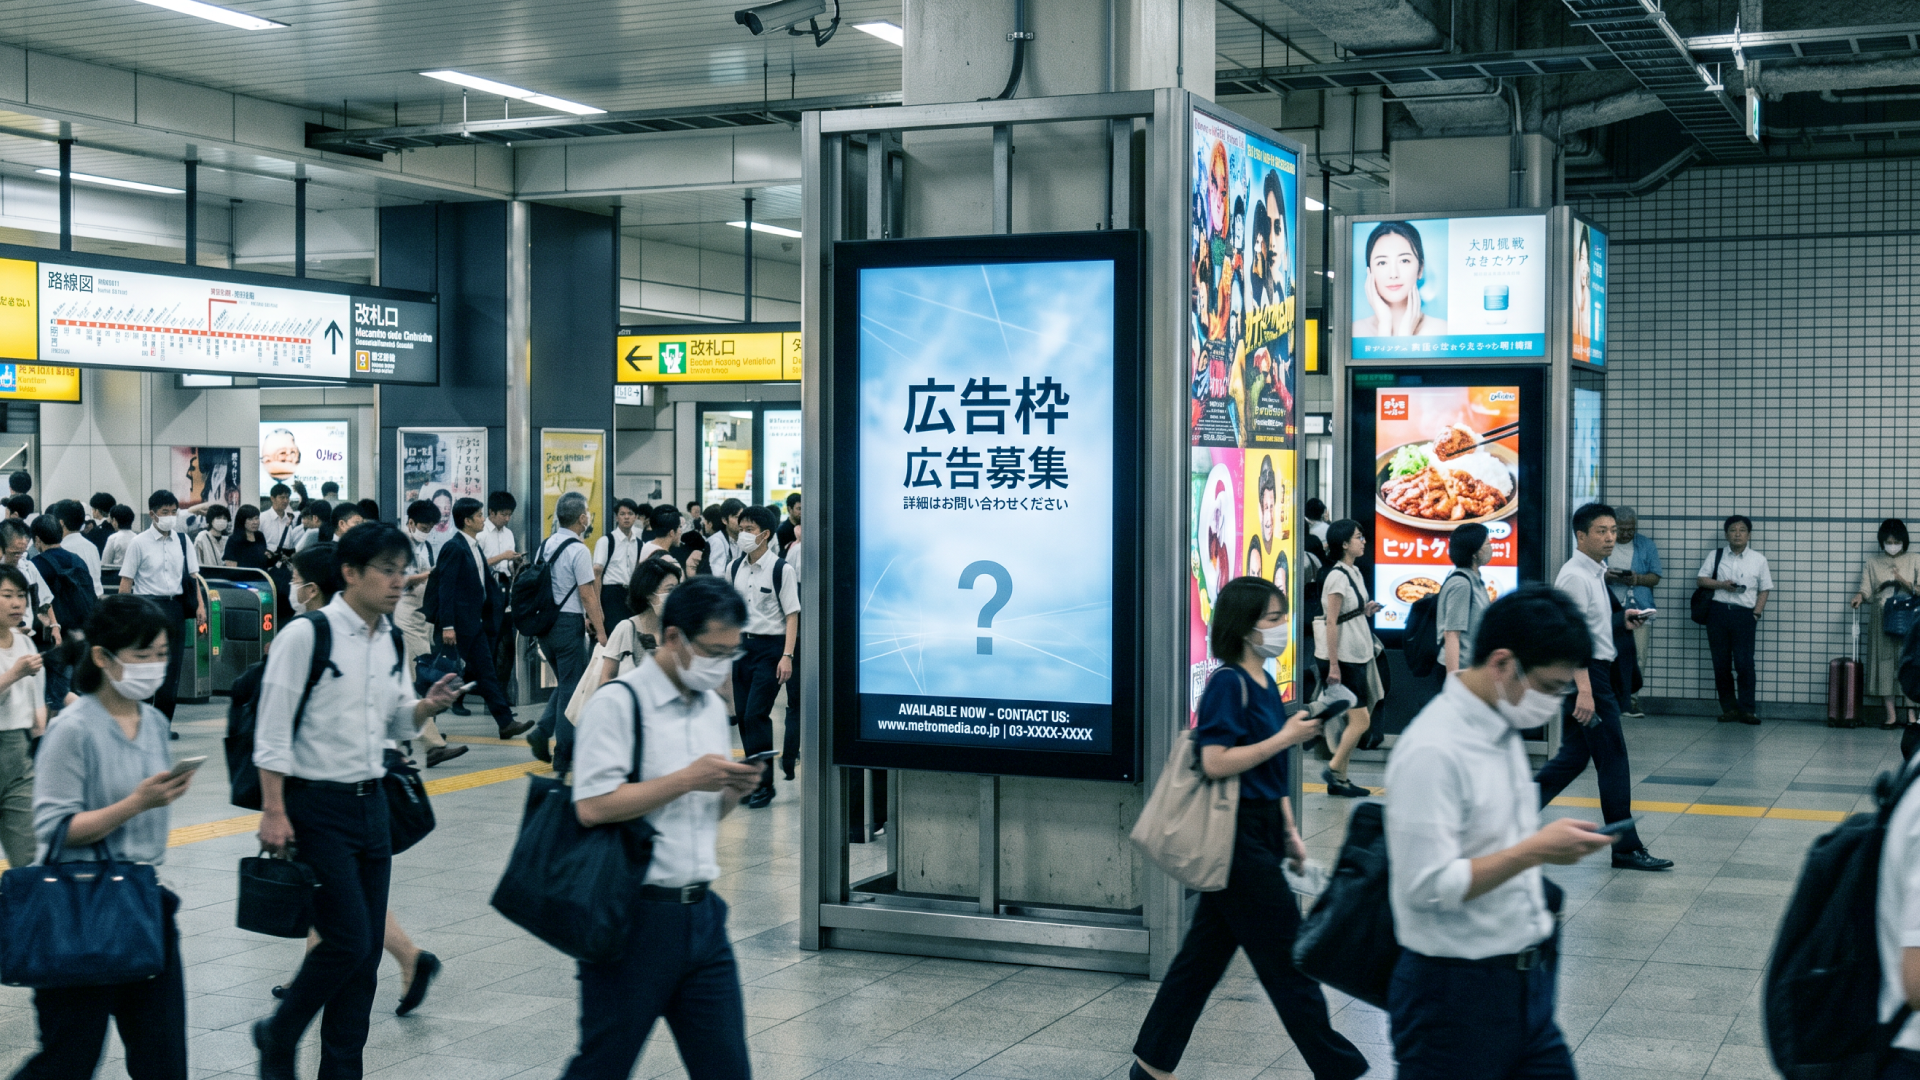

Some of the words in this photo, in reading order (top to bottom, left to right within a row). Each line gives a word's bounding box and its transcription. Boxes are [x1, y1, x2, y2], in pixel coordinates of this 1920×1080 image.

[48, 271, 93, 293] 路線図
[355, 302, 399, 328] 改札口
[690, 339, 735, 356] 改札口
[903, 376, 1070, 435] 広告枠
[903, 446, 1069, 489] 広告募集
[903, 496, 1068, 511] 詳細はお問い合わせください
[1383, 538, 1449, 558] ヒットケ
[957, 559, 1013, 655] ?
[898, 703, 957, 718] AVAILABLE
[960, 706, 987, 719] NOW
[997, 708, 1049, 722] CONTACT
[1051, 710, 1070, 723] US:
[877, 720, 1000, 738] www.metromedia.co.jp
[1009, 724, 1093, 741] 03-XXXX-XXXX
